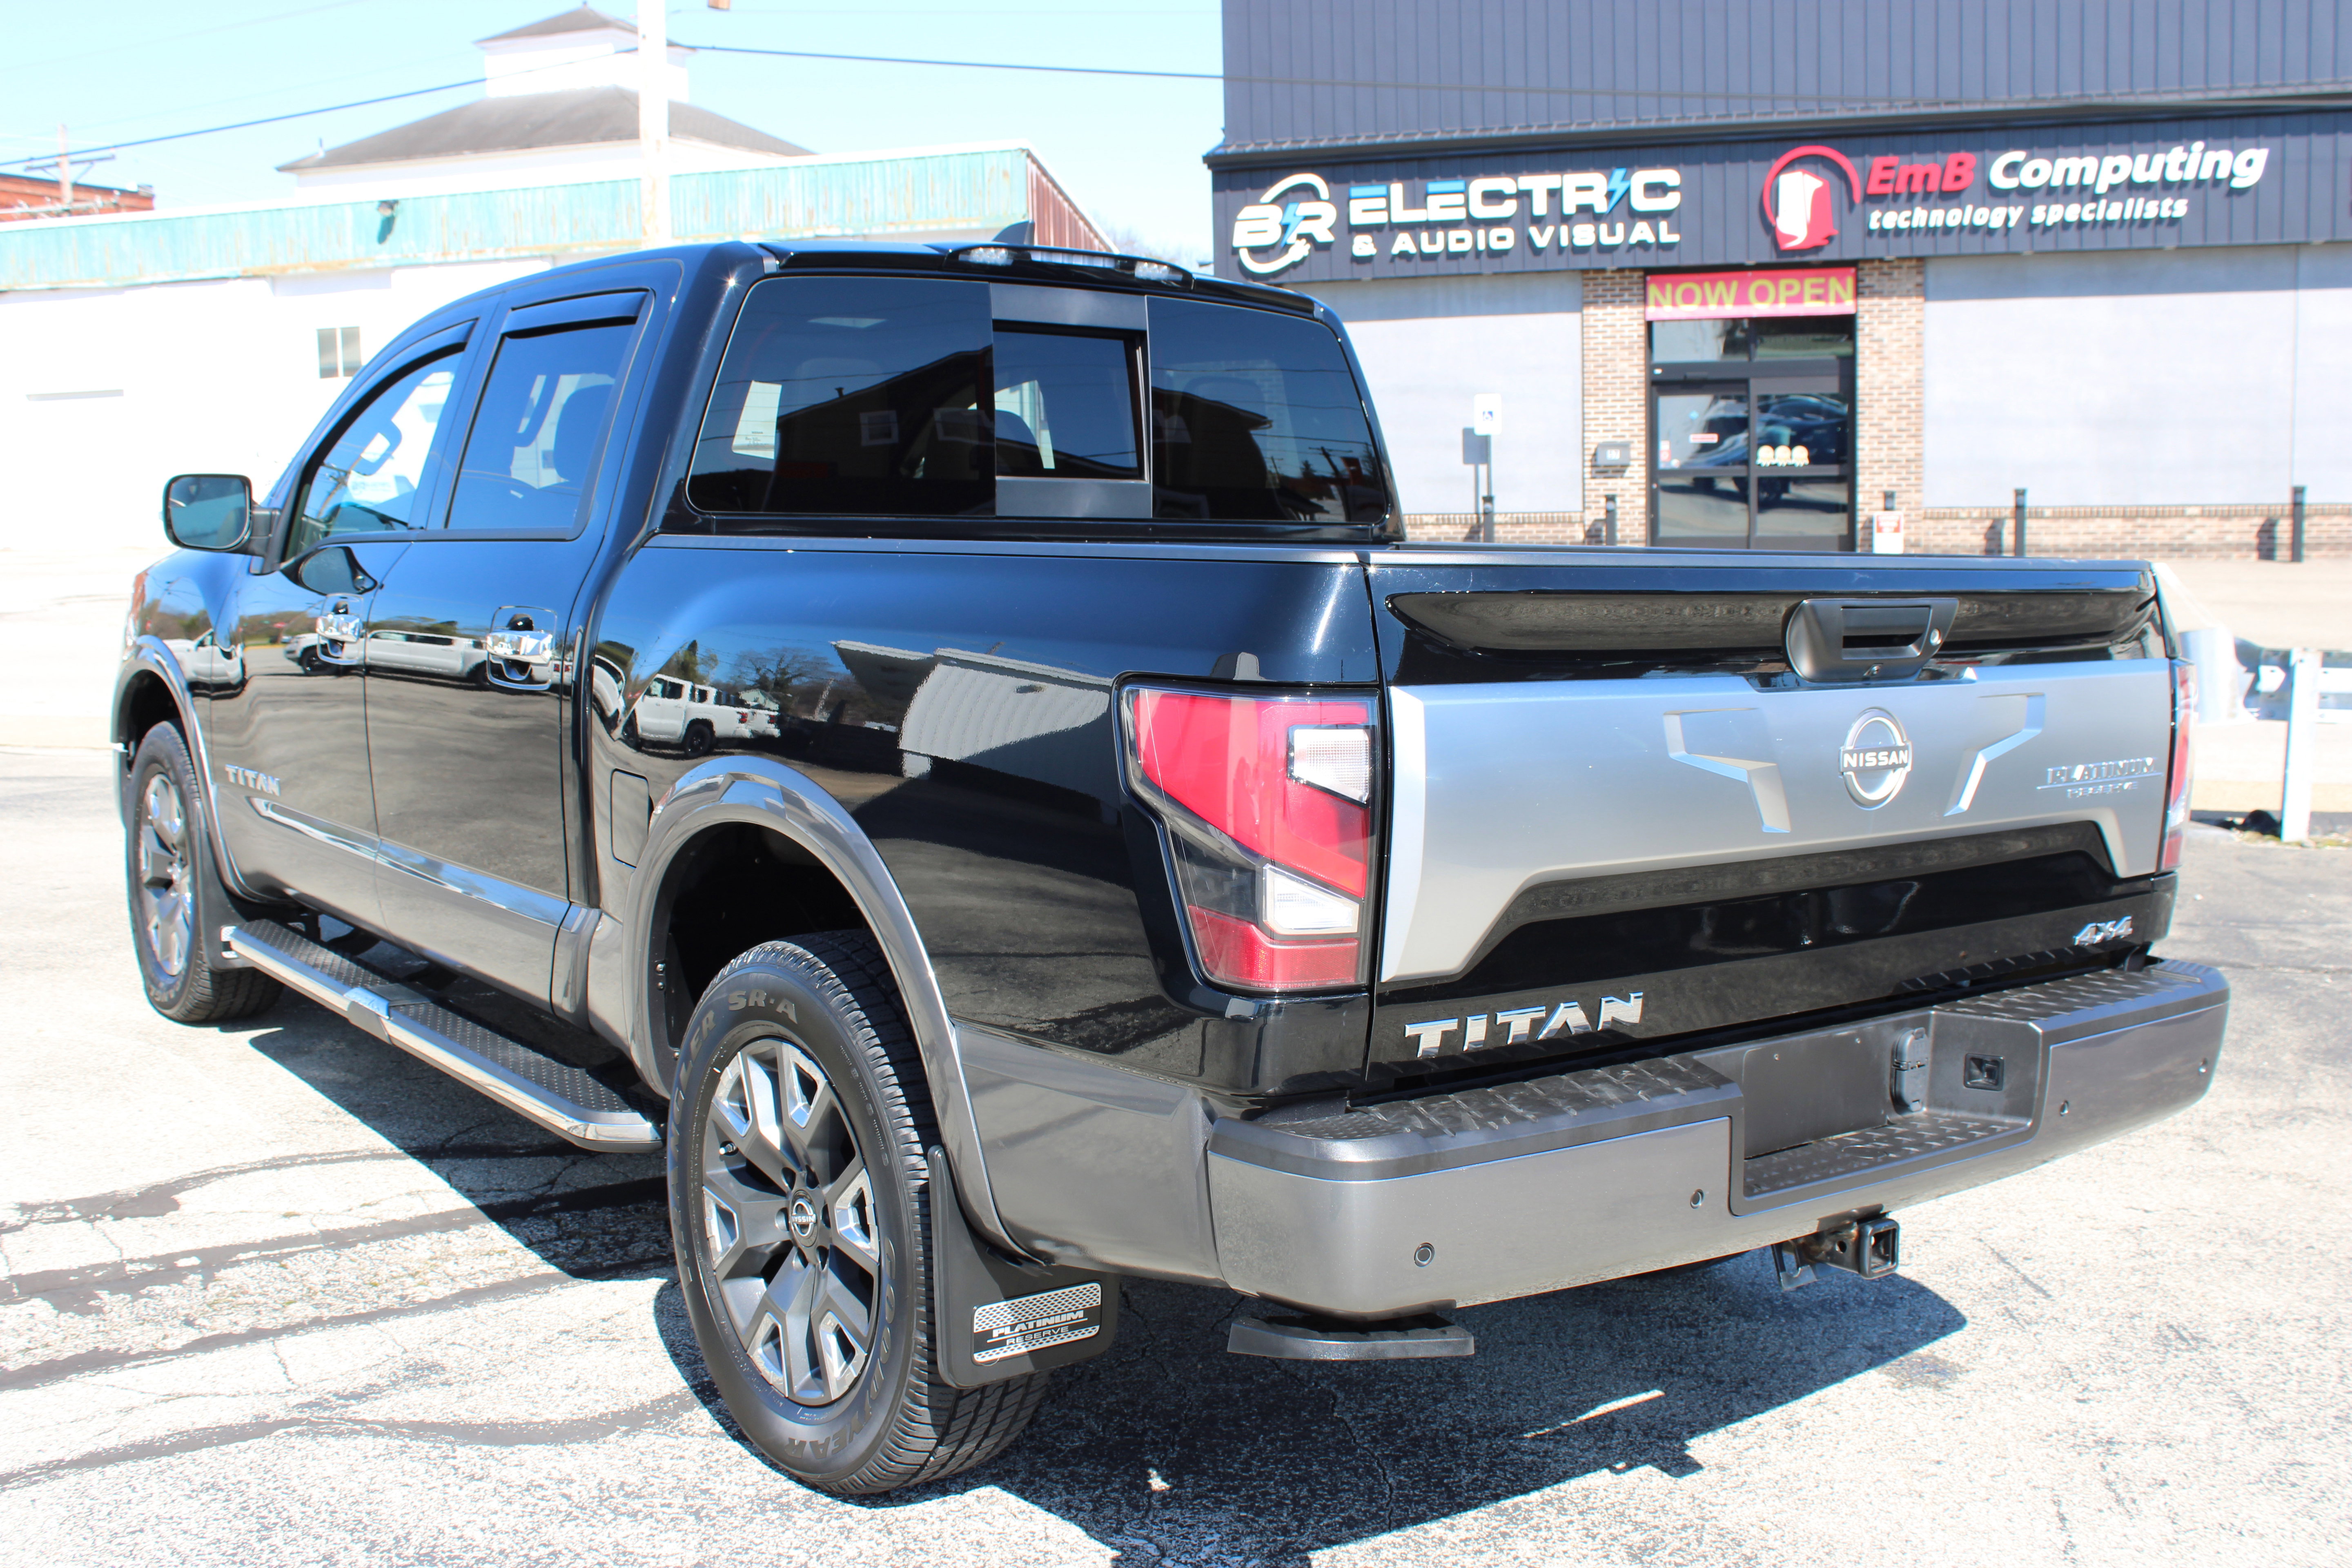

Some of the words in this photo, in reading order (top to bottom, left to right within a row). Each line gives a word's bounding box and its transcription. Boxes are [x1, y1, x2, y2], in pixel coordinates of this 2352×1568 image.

[1866, 152, 1977, 194] EmB
[1989, 141, 2269, 194] Computing
[1869, 204, 2024, 229] technology
[2031, 197, 2189, 227] specialists
[1352, 234, 1377, 256] &
[1391, 227, 1515, 255] AUDIO
[1528, 221, 1681, 248] VISUAL
[1647, 280, 1738, 313] NOW
[1748, 276, 1854, 310] OPEN
[1843, 750, 1908, 768] NISSAN
[225, 764, 281, 796] TITAN
[1405, 992, 1643, 1058] TITAN
[992, 1310, 1084, 1338] PLATINUM
[1006, 1326, 1069, 1345] RESERVE
[784, 1236, 896, 1459] GOODYEAR
